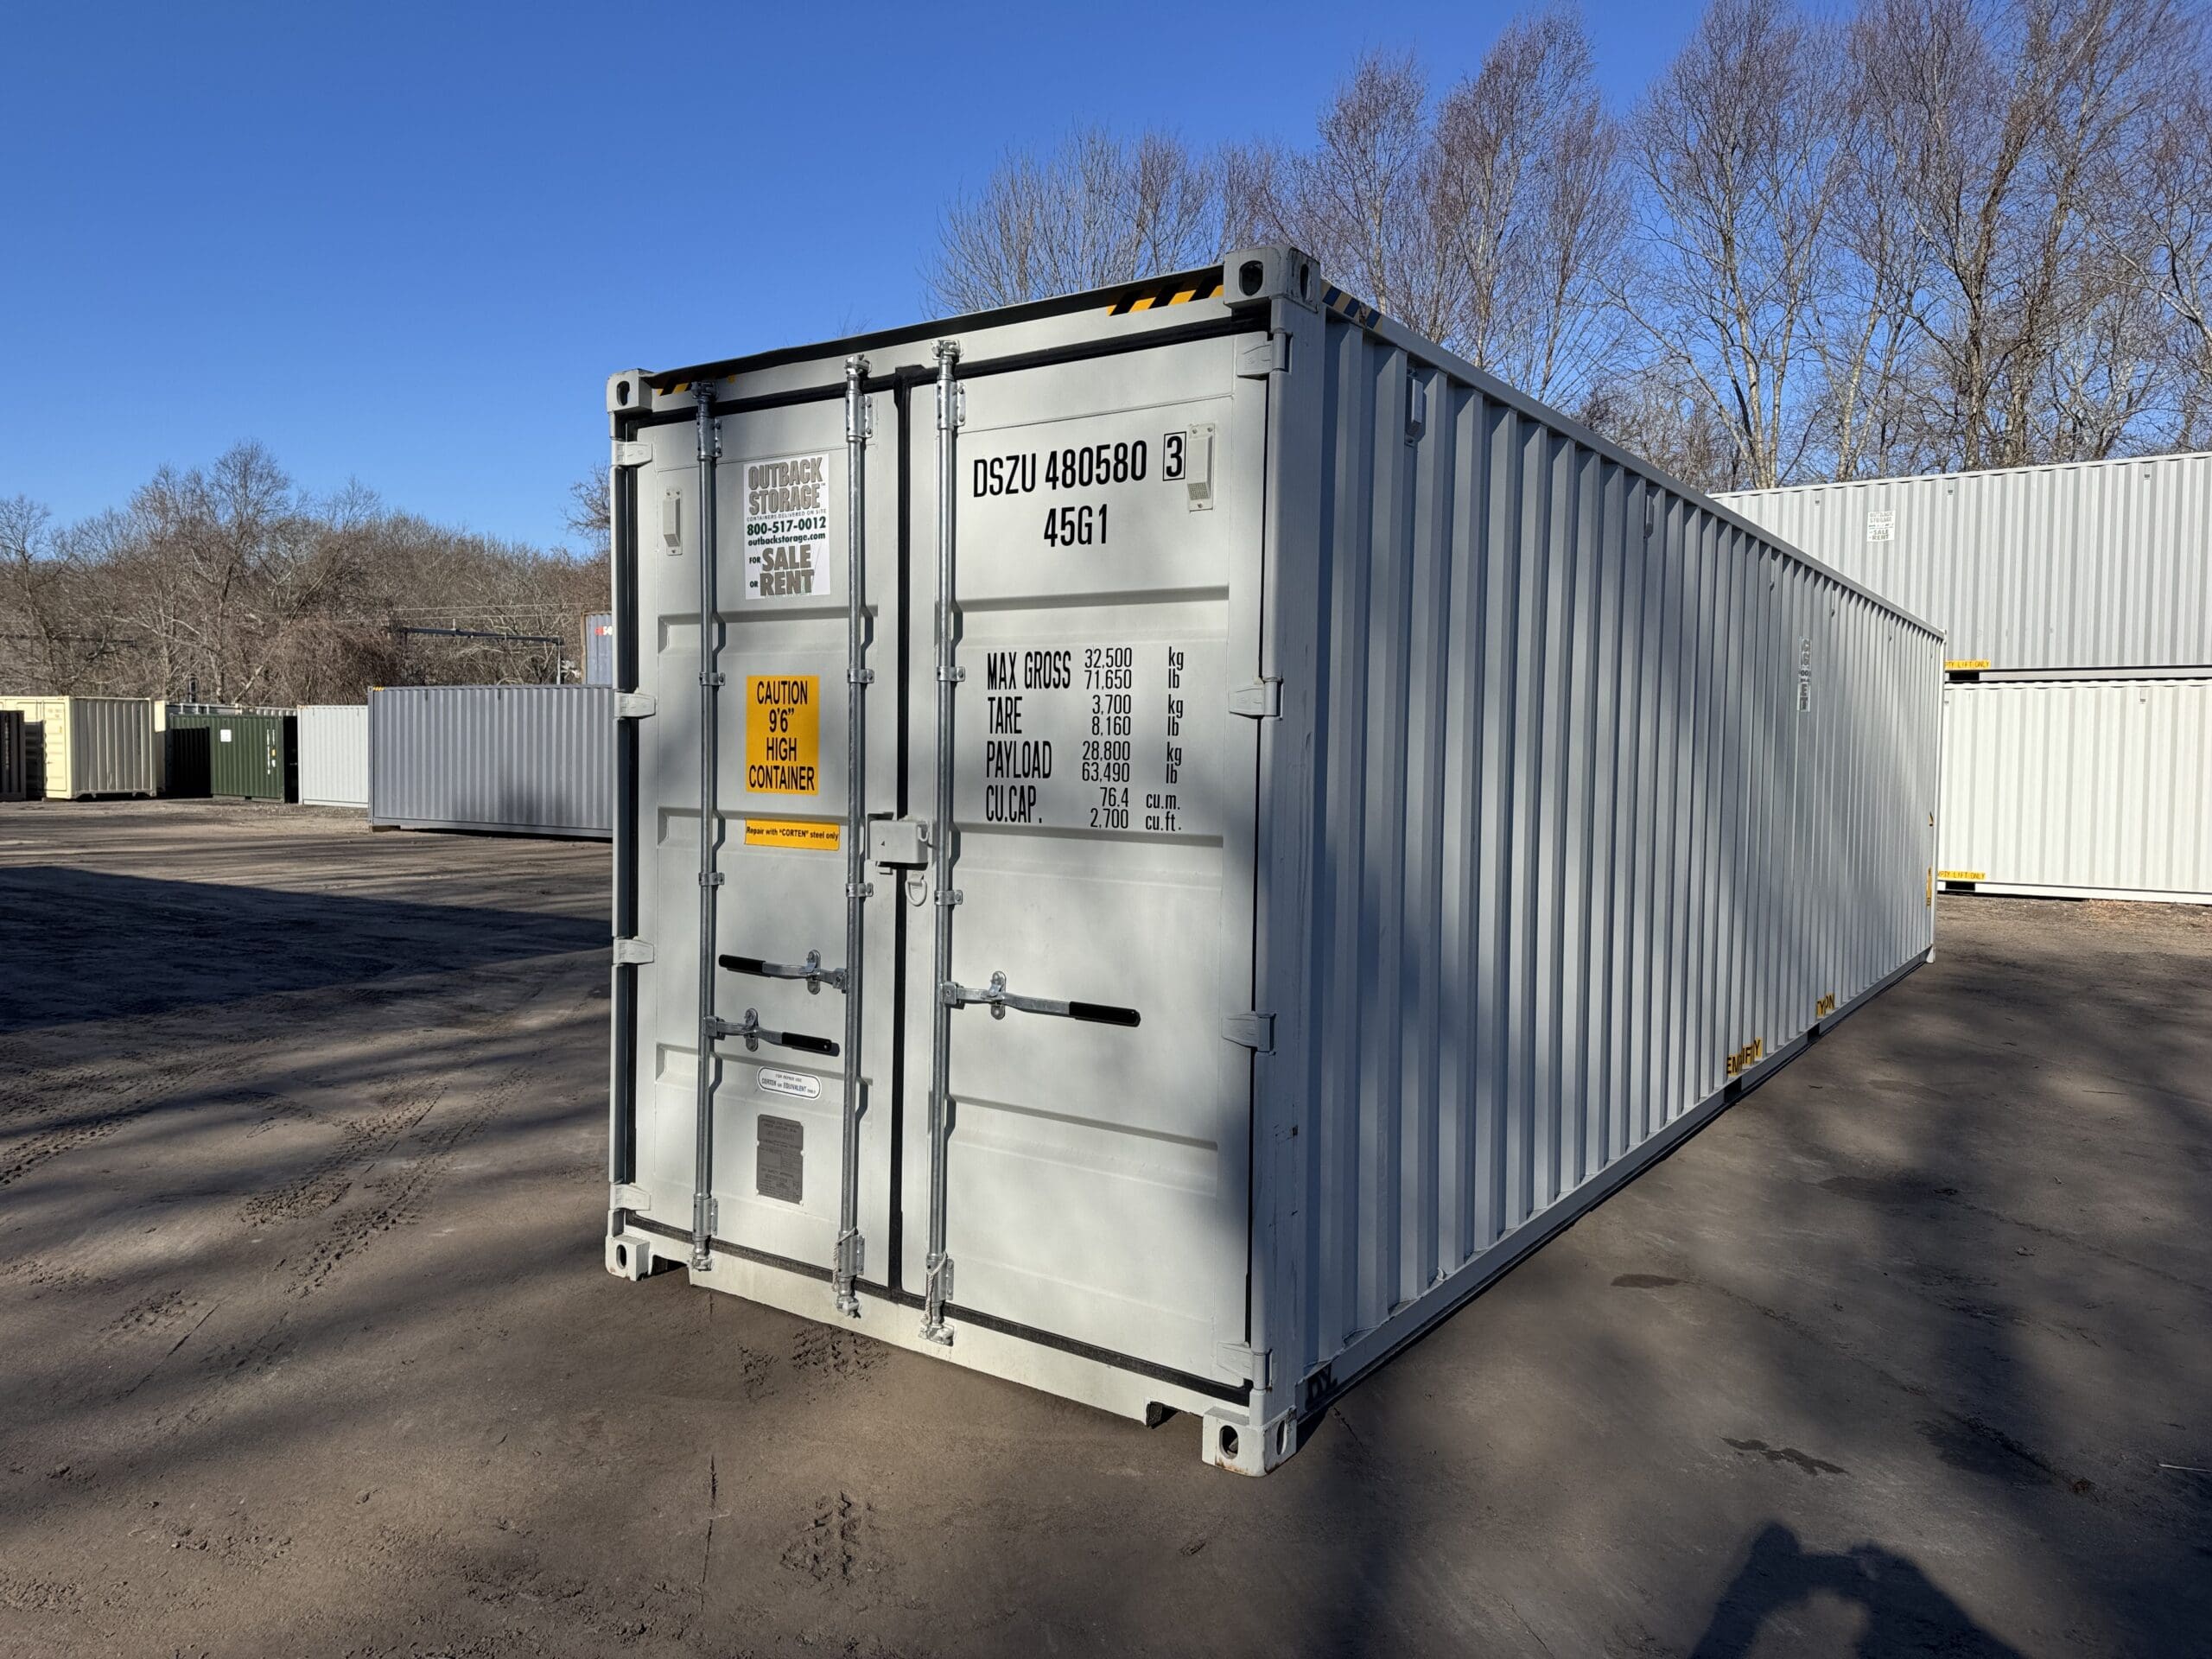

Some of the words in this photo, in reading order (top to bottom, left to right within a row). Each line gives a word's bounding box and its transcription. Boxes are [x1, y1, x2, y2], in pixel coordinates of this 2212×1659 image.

[748, 457, 823, 490] OUTBACK
[973, 453, 1036, 498] DSZU
[1046, 440, 1147, 490] 480580
[1166, 435, 1183, 477] 3
[749, 484, 821, 515] STORAGE
[747, 517, 826, 536] 800-517-0012
[1044, 504, 1108, 547] 45G1
[748, 533, 825, 546] outbackstorage.com
[762, 544, 811, 572] SALE
[749, 580, 759, 588] OR
[760, 569, 815, 597] RENT
[987, 652, 1017, 690] MAX
[1024, 651, 1071, 690] GROSS
[1084, 647, 1132, 669] 32,500
[1168, 646, 1184, 671] kg
[1084, 669, 1132, 690] 71,650
[1168, 669, 1180, 689] lb
[757, 680, 808, 705] CAUTION
[988, 696, 1023, 734] TARE
[1092, 694, 1132, 715] 3,700
[1167, 694, 1184, 718] kg
[1091, 715, 1131, 736] 8,160
[1167, 715, 1179, 736] lb
[766, 737, 798, 761] HIGH
[986, 741, 1052, 779] PAYLOAD
[1082, 741, 1131, 761] 28,800
[1166, 741, 1182, 766] kg
[748, 765, 815, 791] CONTAINER
[1082, 761, 1130, 783] 63,490
[1166, 763, 1178, 784] lb
[1099, 786, 1129, 808] 76.4
[1146, 793, 1181, 810] cu.m.
[1090, 808, 1129, 830] 2,700
[1145, 810, 1182, 831] cu.ft.
[747, 826, 765, 836] Repair
[779, 829, 809, 837] "CORTEN"
[826, 831, 839, 841] only
